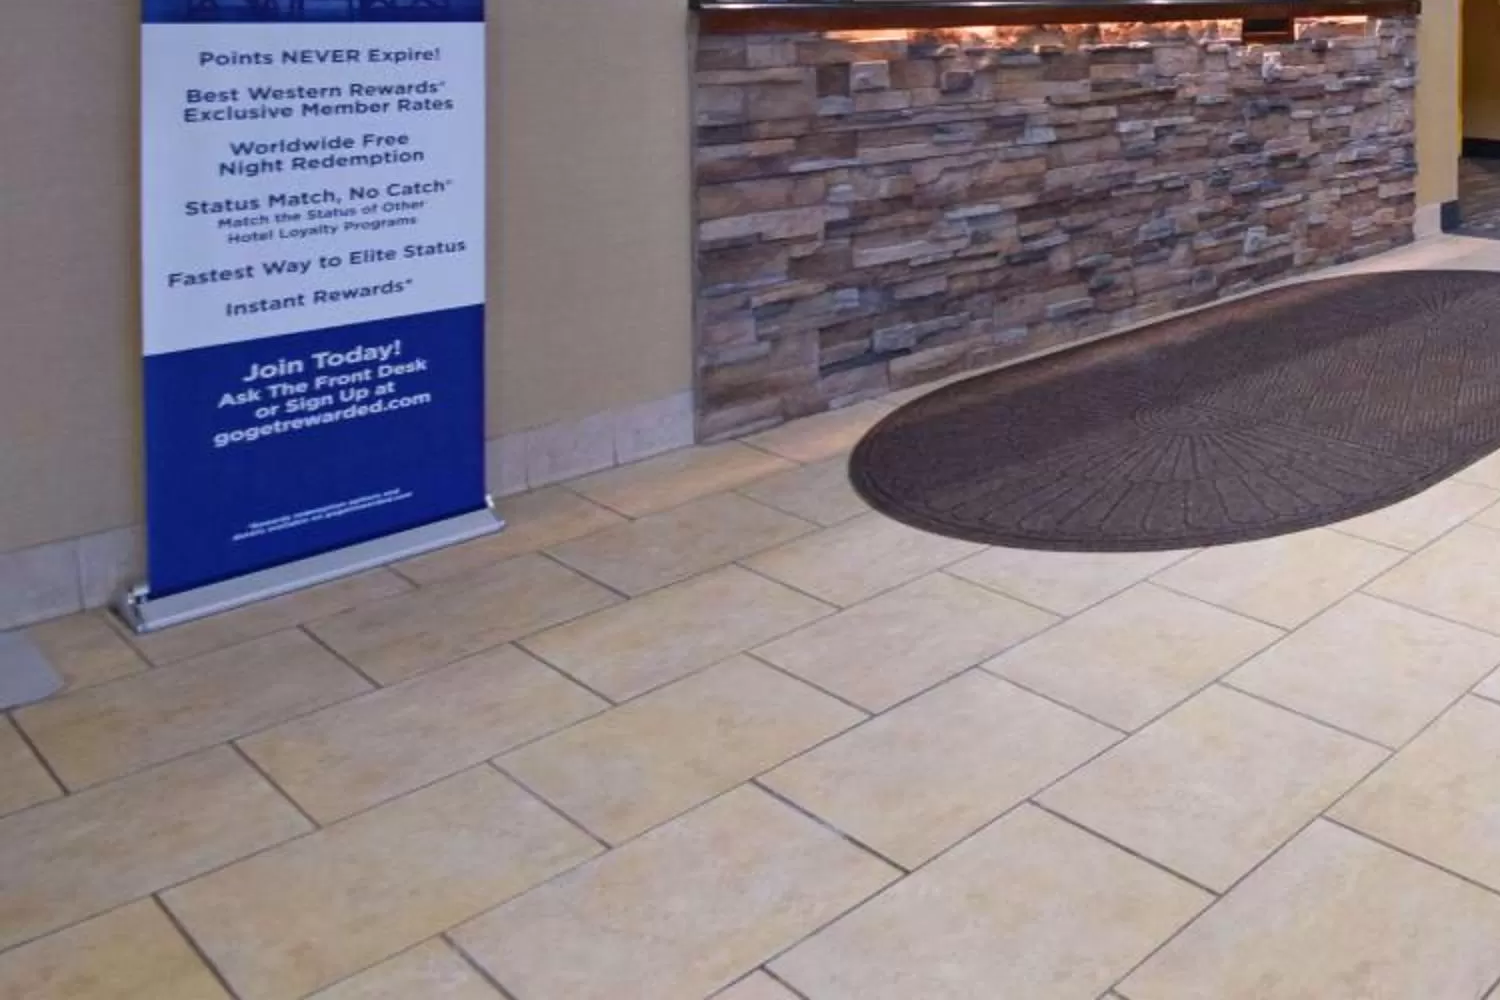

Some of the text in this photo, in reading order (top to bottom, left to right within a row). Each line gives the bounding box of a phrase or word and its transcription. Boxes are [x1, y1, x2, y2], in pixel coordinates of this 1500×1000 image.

[198, 47, 441, 67] Points NEVER Expire!
[186, 87, 240, 104] Best
[247, 84, 342, 101] Western
[183, 97, 455, 123] Exclusive Member Rates
[229, 132, 411, 156] Worldwide Free
[218, 149, 425, 178] Night Redemption
[184, 197, 261, 216] Status
[268, 188, 342, 208] Match,
[349, 186, 380, 201] No
[218, 200, 425, 229] Match the Status of Other
[227, 216, 418, 244] Hotel Loyalty Programs
[167, 240, 466, 288] Fastest Way to Elite Status
[226, 292, 306, 317] Instant
[242, 338, 402, 383] Join Today!
[217, 357, 428, 409] Ask The Front Desk
[255, 380, 397, 420] or Sign Up at
[212, 391, 433, 449] gogetrewarded.com
